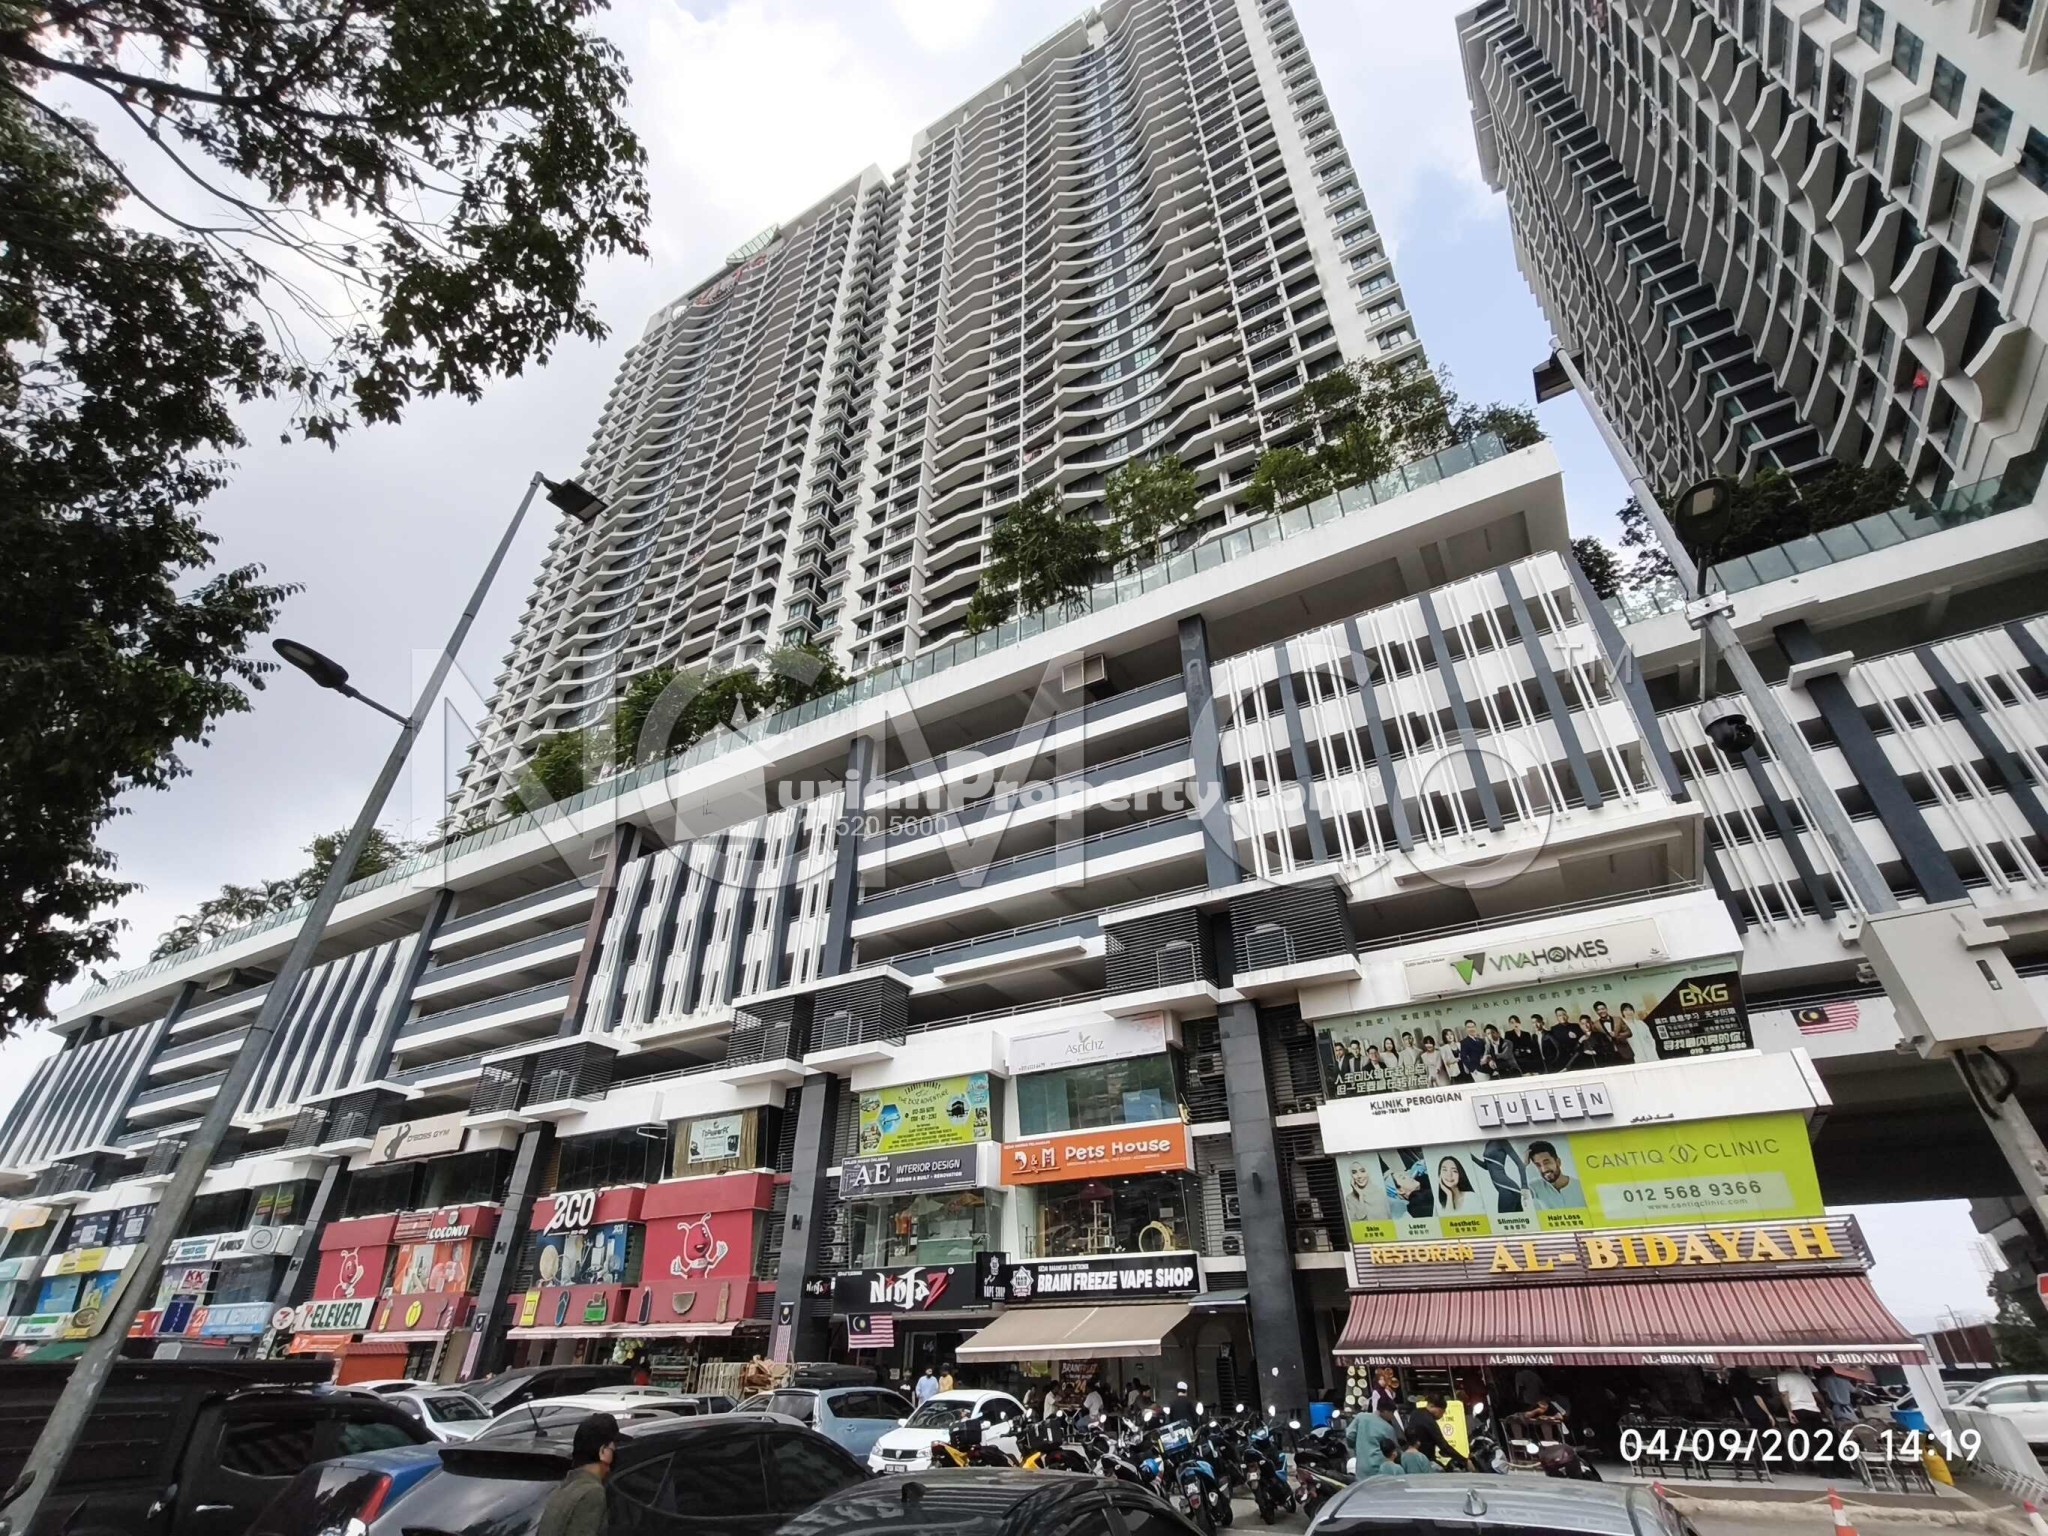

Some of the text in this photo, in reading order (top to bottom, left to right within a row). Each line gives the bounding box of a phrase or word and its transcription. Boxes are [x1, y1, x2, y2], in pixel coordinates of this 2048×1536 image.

[1489, 939, 1609, 973] VIVAHOMES
[1679, 982, 1729, 1007] BKG
[1370, 1092, 1462, 1110] KLINIK PERGIGIAN
[1480, 1092, 1604, 1117] TULEN
[433, 1129, 451, 1138] GYM
[1042, 1147, 1056, 1167] M
[1065, 1144, 1105, 1161] Pets
[1112, 1139, 1171, 1155] House
[1586, 1138, 1780, 1169] CANTIQ CLINIC
[852, 1162, 891, 1187] AE
[896, 1163, 930, 1174] INTERIOR
[931, 1159, 961, 1170] DESIGN
[934, 1171, 963, 1179] RENOVATION
[1623, 1180, 1762, 1203] 012 568 9366
[1647, 1197, 1748, 1210] www.cantiqclinic.com
[1449, 1219, 1480, 1228] Aesthetic
[1497, 1217, 1530, 1226] Slimming
[1370, 1222, 1843, 1273] RESTORAN AL-BIDAYAH
[1037, 1266, 1194, 1293] BRAIN FREEZE VAPE SHOP
[1353, 1356, 1412, 1366] AL-BIDAYAH
[1489, 1354, 1554, 1365] AL-BIDAYAH
[1641, 1354, 1715, 1365] AL-BIDAYAH
[1816, 1353, 1900, 1364] AL-BIDAYAH
